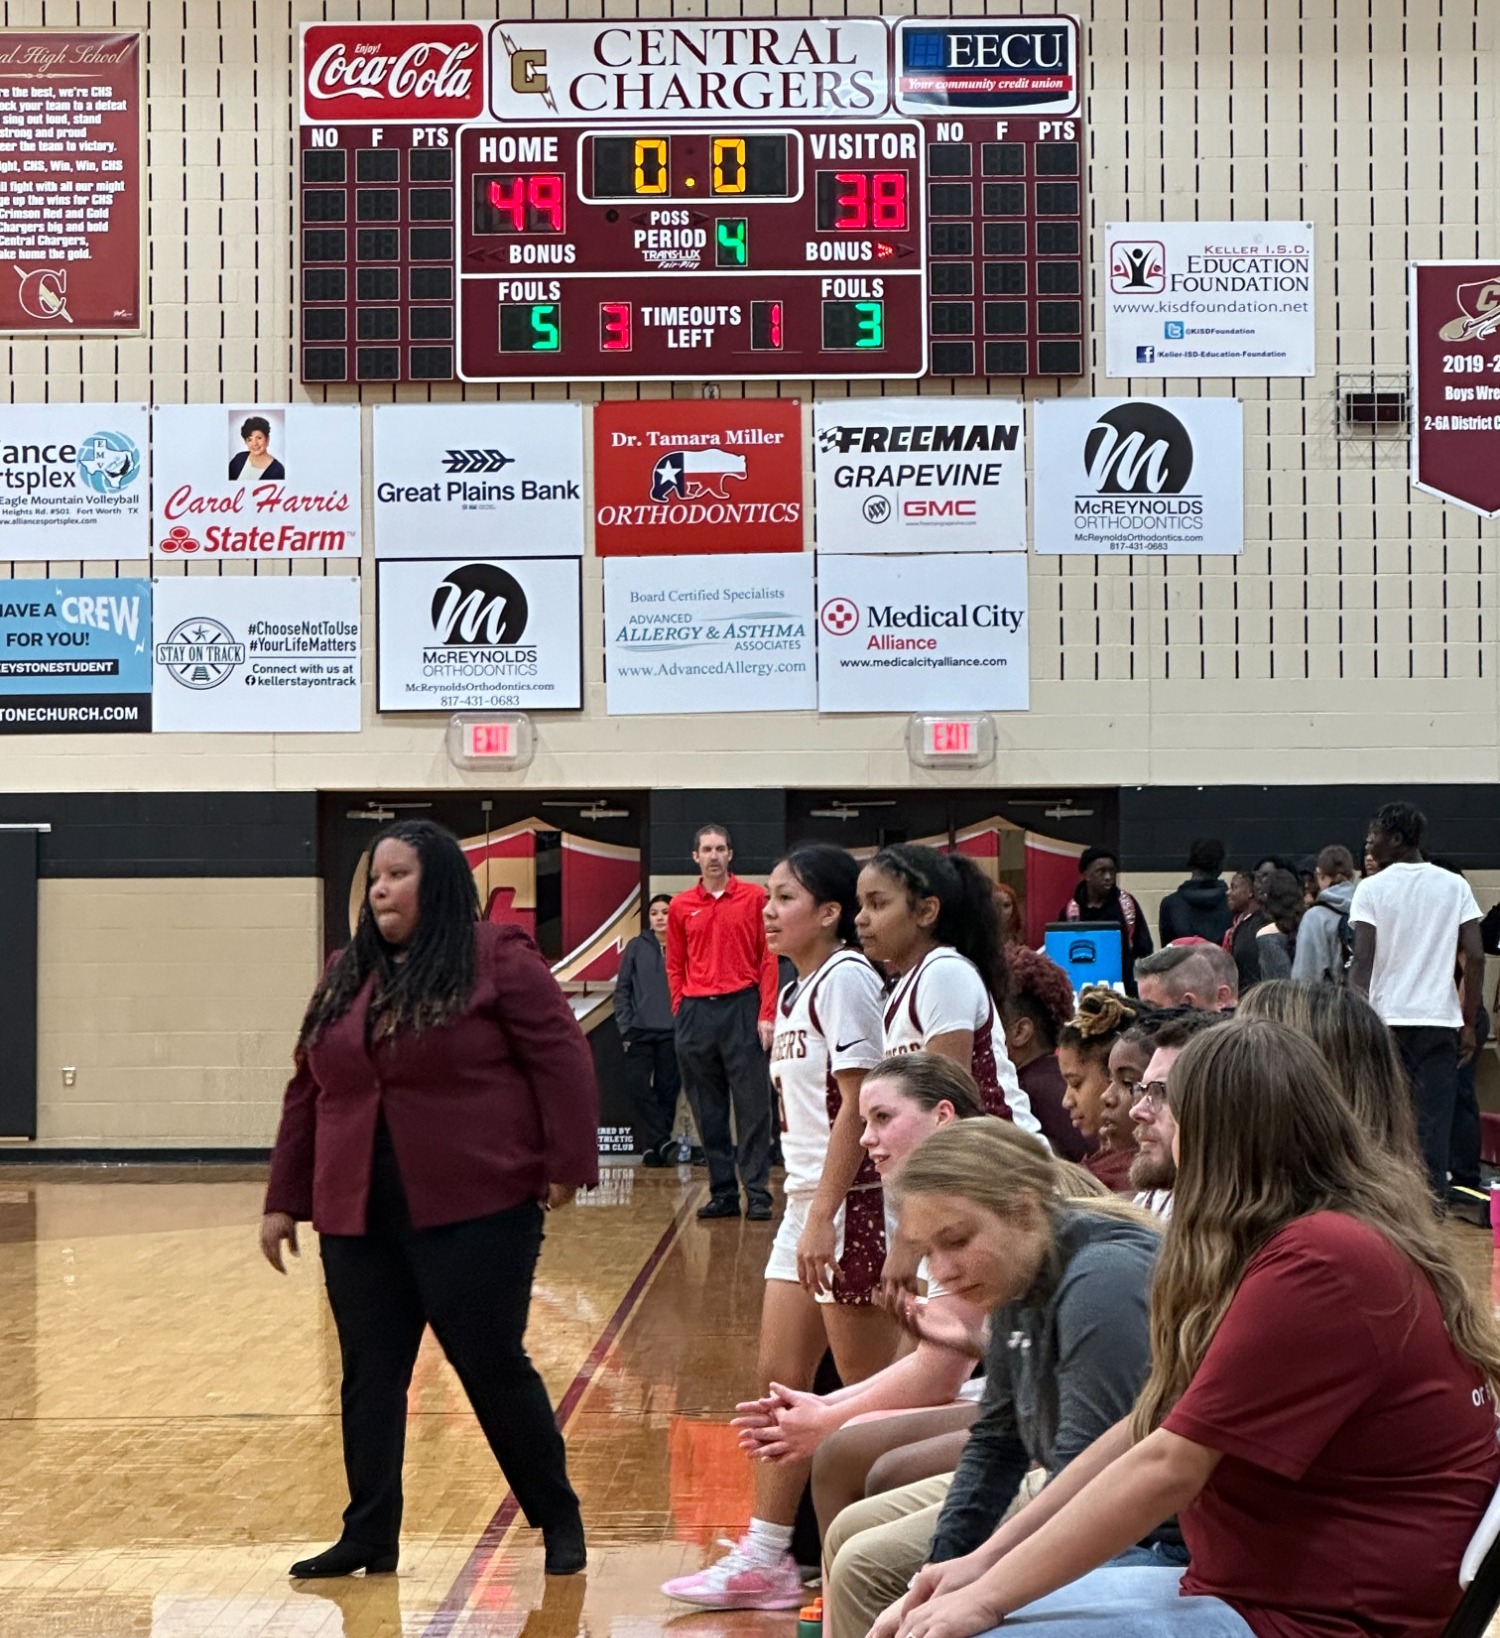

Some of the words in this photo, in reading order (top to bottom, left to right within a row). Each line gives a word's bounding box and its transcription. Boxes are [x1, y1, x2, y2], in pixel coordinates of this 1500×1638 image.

[355, 43, 381, 55] Enjoy!
[593, 27, 857, 67] CENTRAL
[947, 33, 1064, 69] EECU
[17, 44, 69, 72] High
[69, 44, 130, 64] School
[308, 41, 480, 100] Coca-Cola
[12, 86, 29, 97] the
[31, 86, 56, 99] best,
[91, 86, 112, 97] CHS
[568, 69, 875, 112] CHARGERS
[908, 77, 934, 90] Your
[935, 78, 997, 92] community
[998, 78, 1030, 89] credit
[1031, 78, 1063, 89] union
[19, 101, 43, 113] your
[46, 100, 71, 111] team
[95, 99, 127, 111] defeat
[2, 113, 24, 126] sing
[73, 113, 102, 125] stand
[35, 127, 54, 138] and
[56, 127, 87, 139] proud
[311, 127, 338, 148] NO
[372, 128, 383, 147] F
[412, 127, 449, 147] PTS
[936, 122, 964, 142] NO
[996, 121, 1008, 141] F
[1038, 120, 1075, 141] PTS
[19, 140, 36, 151] the
[38, 140, 64, 151] team
[79, 140, 117, 153] victory.
[479, 136, 558, 163] HOME
[810, 132, 917, 160] VISITOR
[23, 160, 48, 173] CHS,
[50, 160, 73, 173] Win,
[75, 160, 99, 173] Win,
[101, 159, 123, 171] CHS
[10, 181, 33, 193] fight
[35, 181, 58, 192] with
[96, 180, 125, 193] might
[47, 194, 71, 206] wins
[91, 194, 113, 205] CHS
[489, 176, 562, 232] 49
[835, 172, 906, 229] 38
[43, 208, 63, 219] Red
[65, 208, 84, 219] and
[86, 208, 109, 219] Gold
[650, 210, 689, 226] POSS
[66, 222, 84, 232] and
[87, 222, 109, 232] bold
[37, 235, 89, 247] Chargers,
[634, 229, 707, 249] PERIOD
[718, 221, 745, 264] 4
[19, 249, 46, 260] home
[67, 249, 92, 261] gold.
[509, 243, 576, 264] BONUS
[805, 241, 873, 262] BONUS
[1204, 245, 1258, 254] KELLER
[1266, 245, 1310, 254] I.S.D.
[1187, 255, 1309, 274] EDUCATION
[821, 278, 884, 298] FOULS
[1170, 273, 1310, 292] FOUNDATION
[498, 281, 561, 301] FOULS
[1113, 301, 1309, 313] www.kisdfoundation.net
[641, 305, 741, 327] TIMEOUTS
[530, 305, 558, 350] 5
[602, 304, 630, 349] 3
[770, 303, 781, 348] 1
[855, 303, 882, 348] 3
[667, 328, 714, 349] LEFT
[1442, 354, 1484, 373] 2019
[1444, 385, 1474, 401] Boys
[1424, 415, 1450, 430] 2-6A
[1451, 415, 1493, 430] District
[611, 432, 642, 447] Dr.
[646, 431, 721, 446] Tamara
[725, 428, 784, 445] Miller
[838, 425, 1020, 453] FREEMAN
[0, 465, 76, 495] tsplex
[834, 463, 1003, 488] GRAPEVINE
[377, 482, 441, 503] Great
[447, 481, 515, 501] Plains
[521, 479, 580, 500] Bank
[30, 495, 84, 505] Mountain
[85, 494, 139, 506] Volleyball
[164, 484, 245, 520] Carol
[252, 483, 350, 514] Harris
[1074, 500, 1203, 515] McREYNOLDS
[2, 508, 33, 517] Heights
[76, 507, 94, 515] Fort
[95, 507, 121, 515] Worth
[128, 507, 139, 515] TX
[597, 502, 800, 526] ORTHODONTICS
[903, 500, 976, 517] GMC
[1074, 515, 1203, 530] ORTHODONTICS
[203, 525, 274, 552] State
[1074, 533, 1203, 543] McReynoldsOrthodontics.com
[1110, 542, 1168, 551] 817-431-0683
[630, 591, 665, 603] Board
[668, 589, 720, 602] Certified
[723, 588, 785, 603] Specialists
[0, 603, 40, 617] AVE
[44, 603, 57, 617] A
[61, 596, 140, 641] CREW
[628, 613, 693, 625] ADVANCED
[867, 604, 969, 629] Medical
[972, 604, 1025, 634] City
[248, 621, 358, 636] #ChooseNotToUse
[615, 626, 703, 642] ALLERGY
[705, 625, 720, 640] &
[722, 622, 806, 639] ASTHMA
[6, 632, 43, 647] FOR
[46, 632, 90, 646] YOU!
[249, 637, 357, 652] #YourLifeMatters
[734, 640, 801, 651] ASSOCIATES
[867, 634, 937, 650] Alliance
[160, 646, 185, 662] STAY
[188, 646, 203, 662] ON
[206, 646, 241, 662] TRACK
[422, 650, 537, 664] McREYNOLDS
[252, 664, 297, 674] Connect
[299, 664, 324, 674] with
[326, 665, 340, 674] us
[342, 664, 354, 674] at
[422, 663, 538, 677] ORTHODONTICS
[618, 660, 806, 677] www.AdvancedAllergy.com
[839, 656, 1007, 669] www.medicalcityalliance.com
[257, 676, 356, 688] kellerstayontrack
[405, 682, 555, 693] McReynoldsOrthodontics.com
[440, 695, 520, 707] 817-431-0683
[472, 725, 510, 753] EXIT
[933, 722, 970, 751] EXIT
[612, 1143, 634, 1151] CLUB
